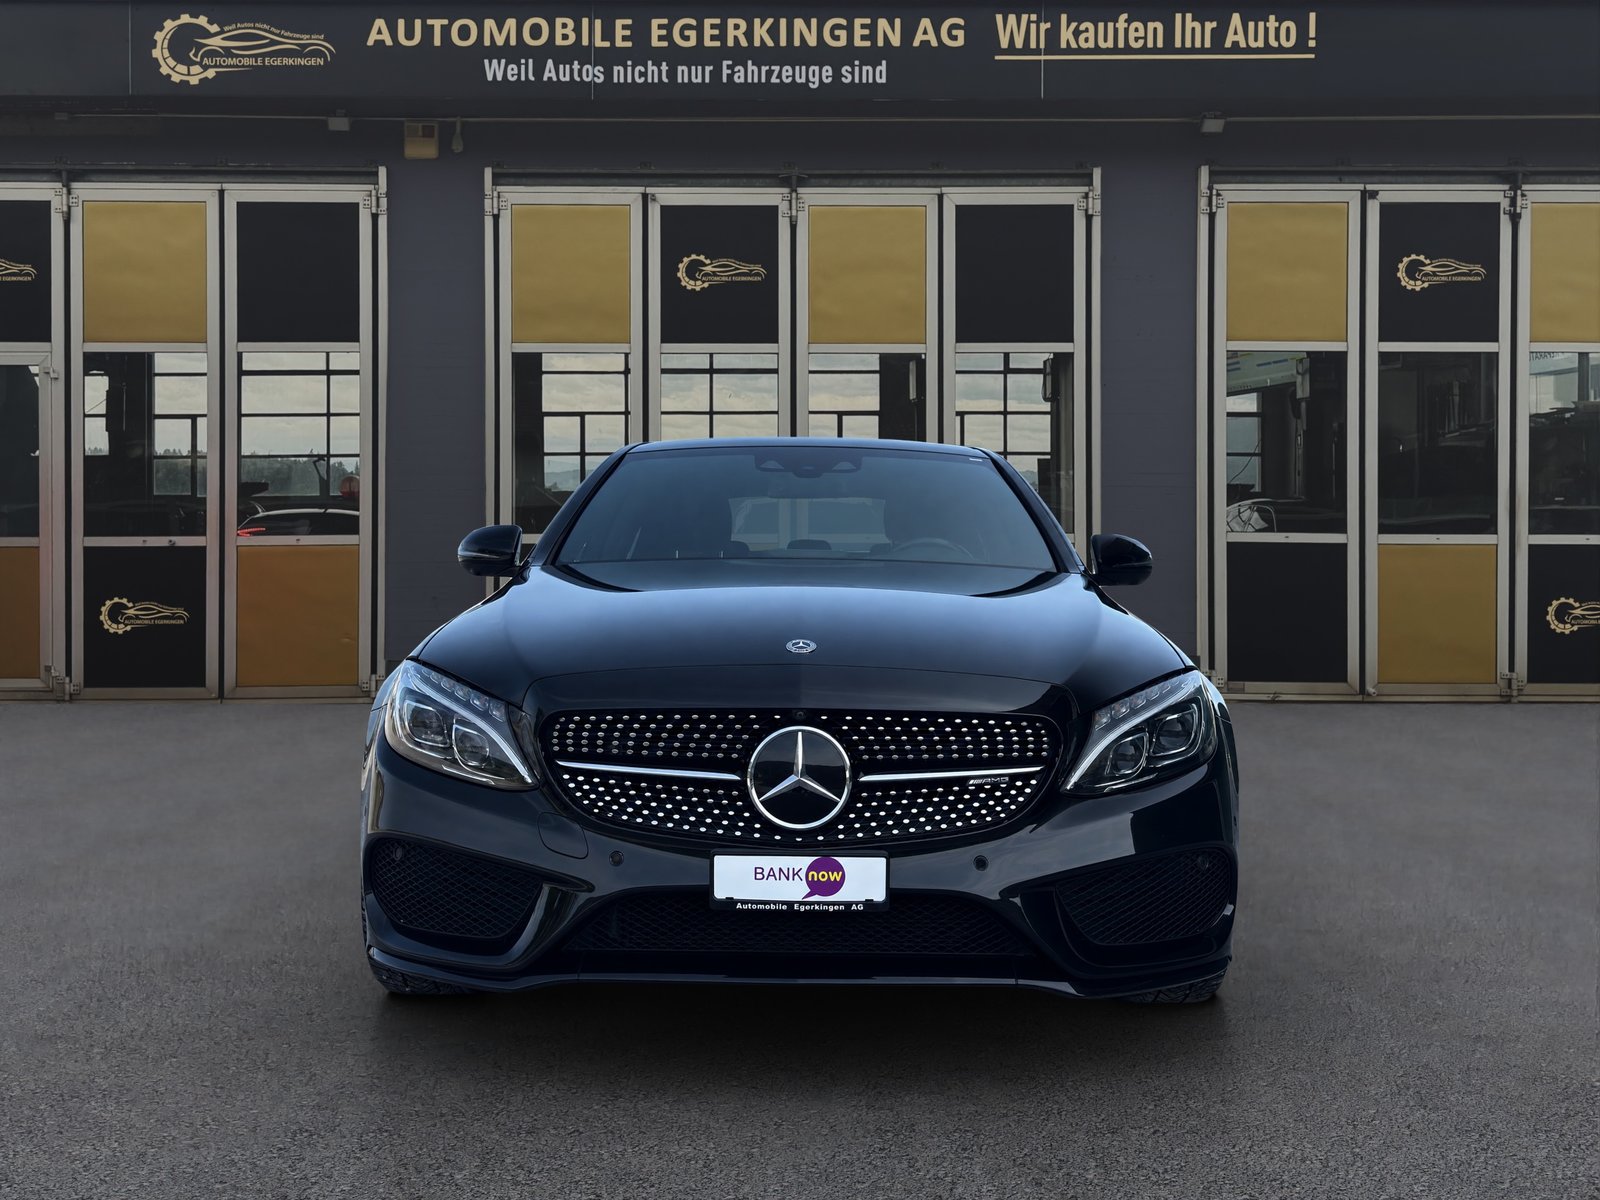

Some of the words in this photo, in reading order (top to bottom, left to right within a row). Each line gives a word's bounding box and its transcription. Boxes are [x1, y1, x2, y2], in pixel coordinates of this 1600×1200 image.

[223, 23, 236, 32] Weil
[255, 22, 270, 31] nicht
[281, 30, 311, 39] Fahrzeuge
[366, 17, 633, 48] AUTOMOBILE
[650, 17, 902, 48] EGERKINGEN
[912, 17, 966, 48] AG
[995, 13, 1052, 49] Wir
[1059, 12, 1164, 49] kaufen
[1174, 12, 1218, 49] Ihr
[1224, 12, 1297, 49] Auto
[203, 57, 263, 66] AUTOMOBILE
[265, 57, 324, 66] EGERKINGEN
[484, 58, 536, 82] Weil
[543, 59, 605, 83] Autos
[612, 60, 669, 84] nicht
[677, 64, 714, 84] nur
[721, 60, 833, 89] Fahrzeuge
[840, 60, 887, 84] sind
[754, 866, 803, 882] BANK
[808, 870, 843, 882] now
[736, 902, 788, 911] Automobile
[794, 903, 845, 912] Egerkingen
